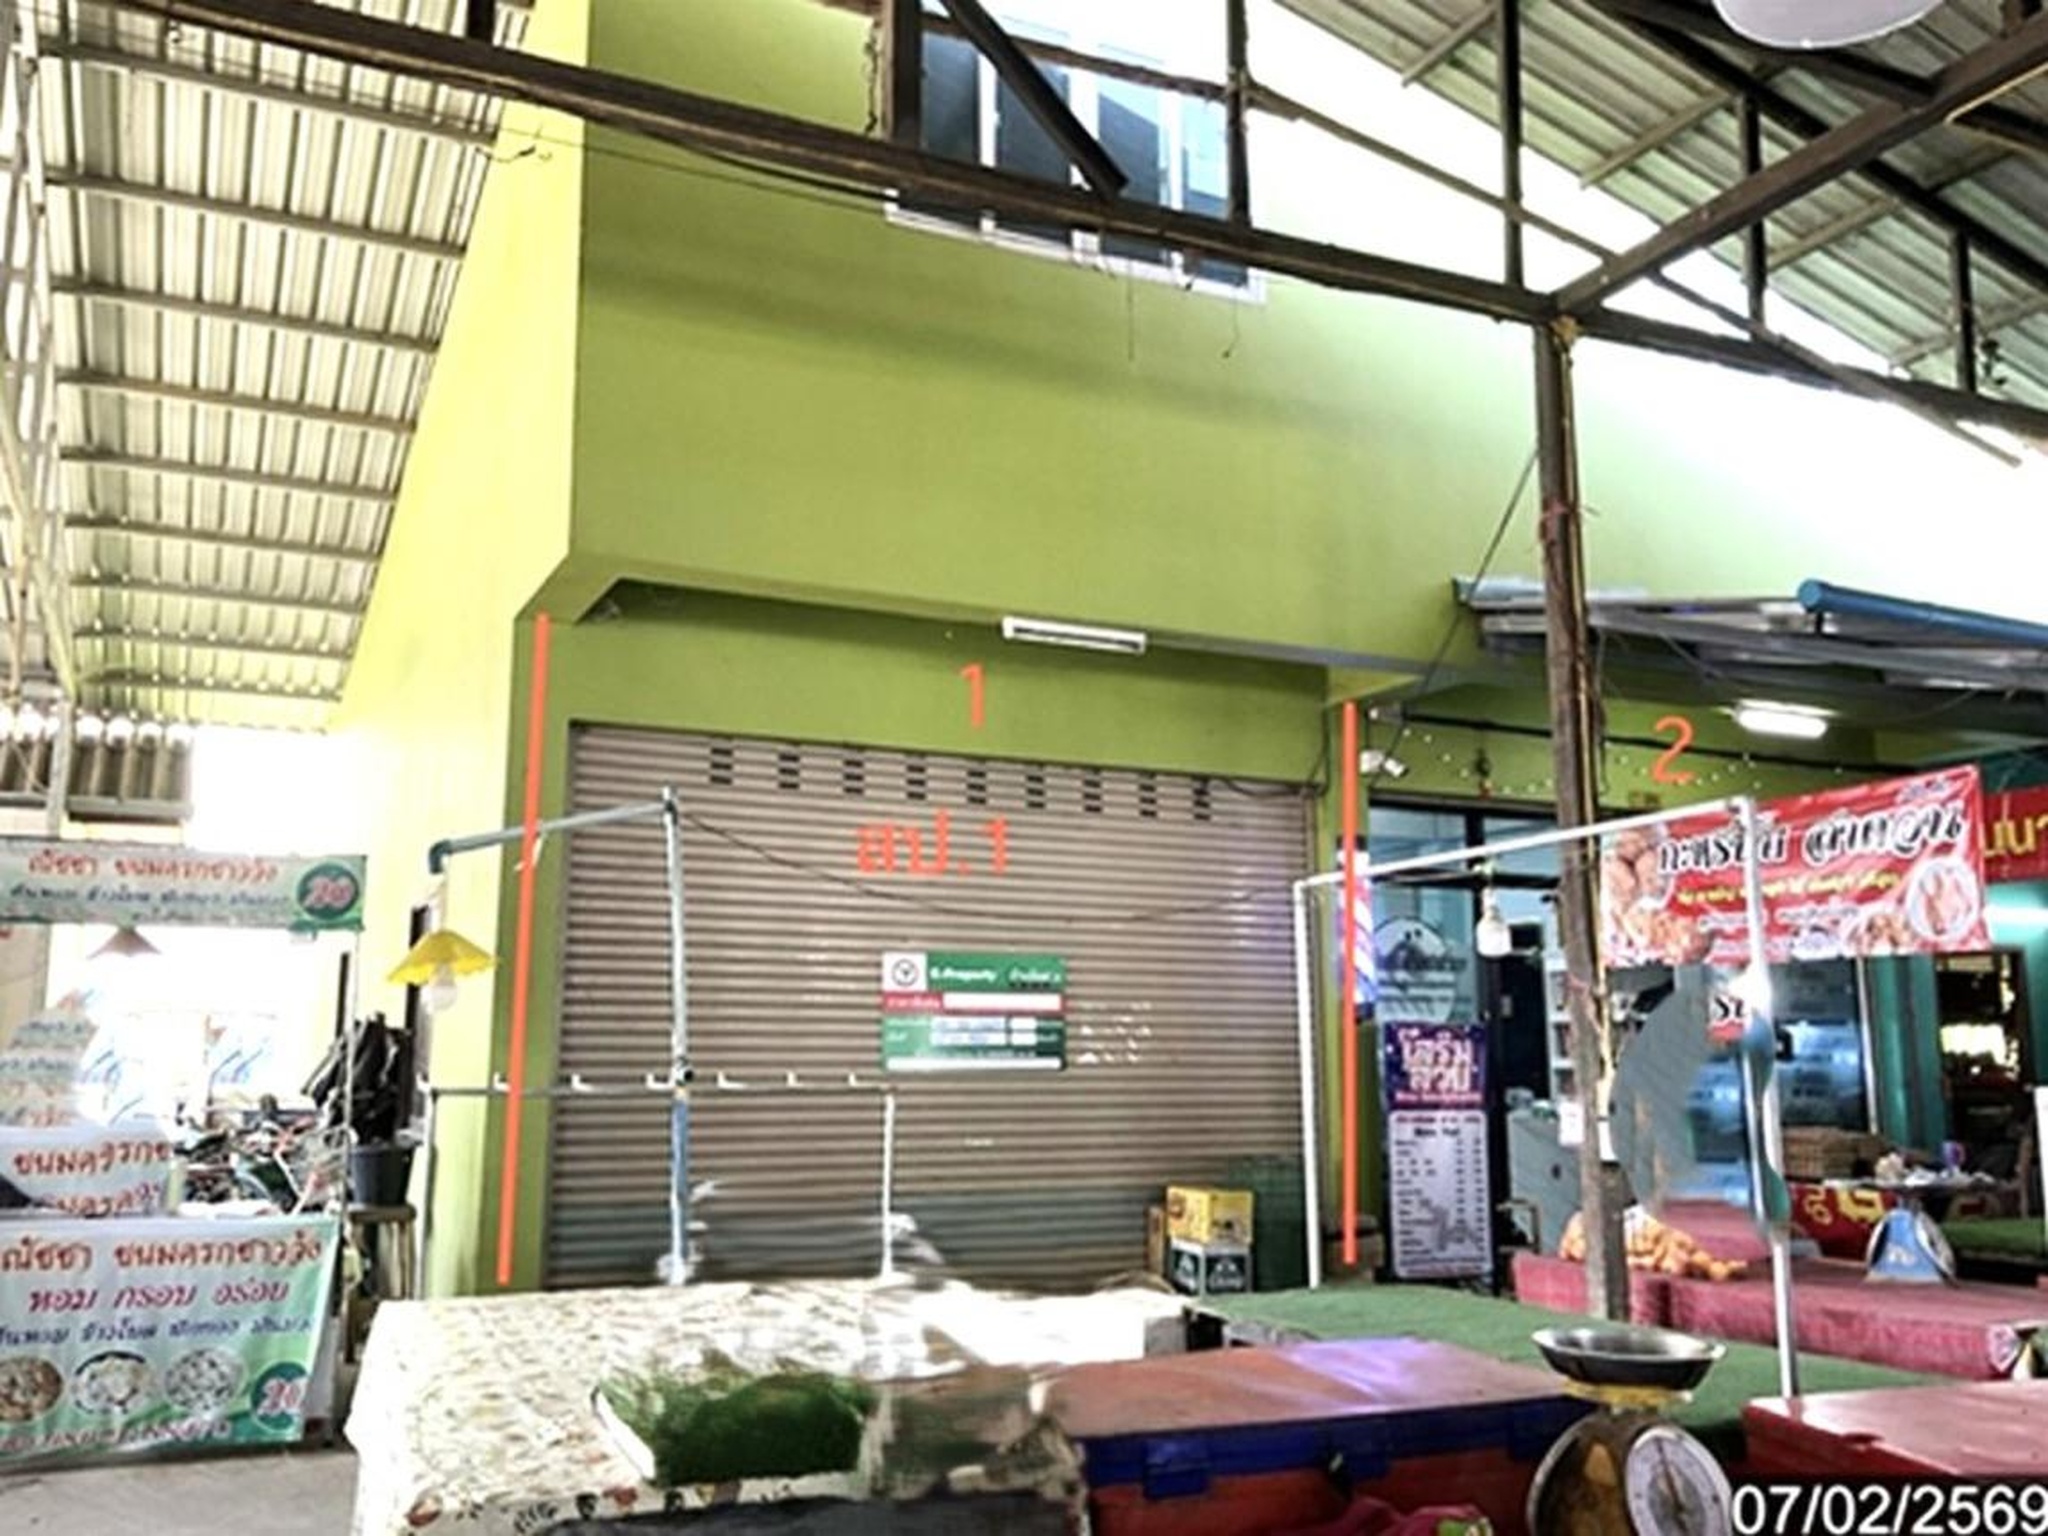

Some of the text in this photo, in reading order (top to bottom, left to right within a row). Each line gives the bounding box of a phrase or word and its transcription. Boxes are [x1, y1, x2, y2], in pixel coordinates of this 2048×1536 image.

[114, 1230, 322, 1268] ขนมครกชาววัง
[29, 1276, 289, 1313] หอม กรอบ อร่อย
